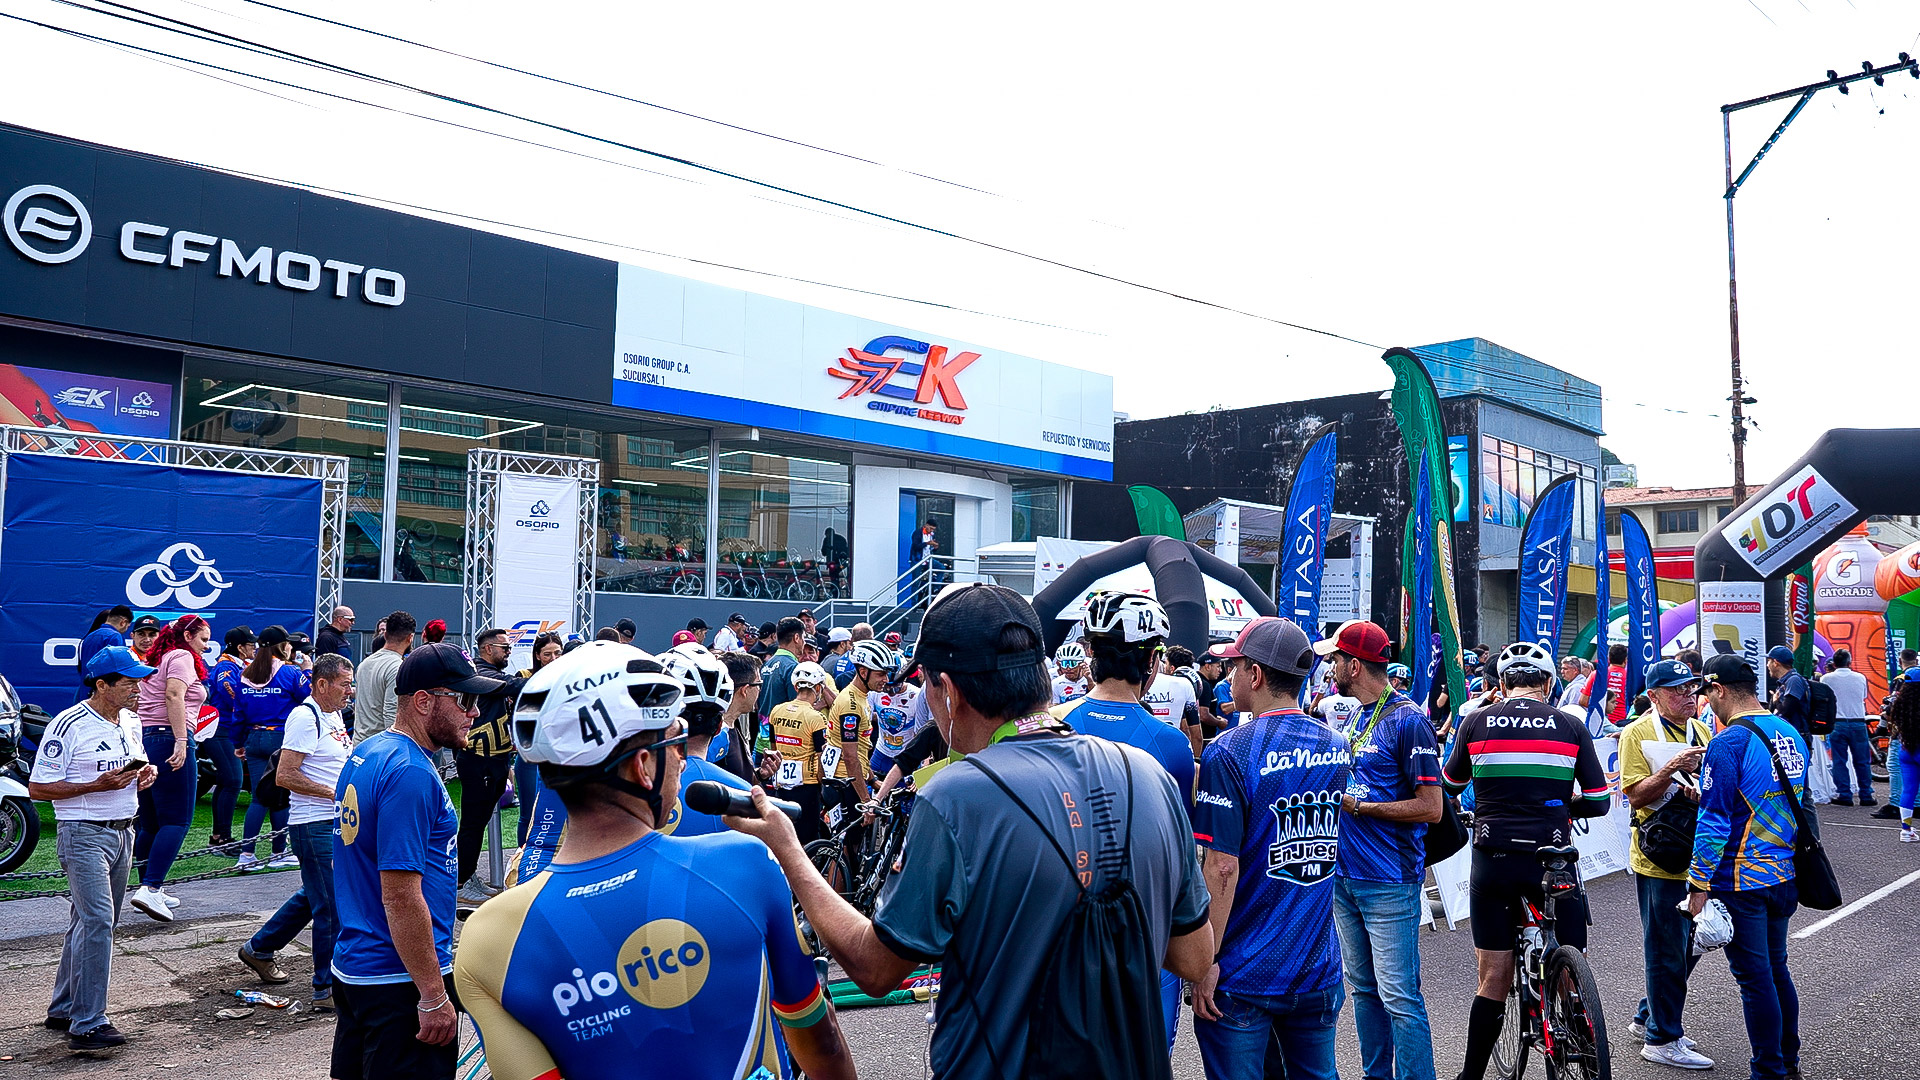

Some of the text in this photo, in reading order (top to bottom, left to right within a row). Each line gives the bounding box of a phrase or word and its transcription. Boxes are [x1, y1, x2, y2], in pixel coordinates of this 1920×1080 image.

[120, 220, 406, 307] CFMOTO
[623, 352, 691, 375] OSORIO GROUP C.A.
[622, 368, 665, 386] SUCURSAL 1
[120, 406, 160, 417] OSORIO
[1042, 430, 1111, 453] REPUESTOS Y SERVICIOS
[515, 519, 560, 529] OSORIO
[1820, 587, 1874, 598] GATORADE
[1702, 602, 1727, 612] Juventud
[1733, 602, 1760, 613] Deporte
[1137, 609, 1156, 634] 42
[856, 652, 867, 663] 53
[241, 687, 282, 695] OSORIO
[577, 697, 619, 747] 41
[642, 708, 670, 719] INEOS
[1486, 714, 1557, 729] BOYACÁ
[1260, 747, 1351, 776] La Nación
[782, 762, 797, 780] 52
[832, 808, 841, 823] 53
[1301, 863, 1321, 877] FM
[552, 940, 705, 1016] pio rico
[567, 1004, 632, 1032] CYCLING
[572, 1023, 614, 1042] TEAM
